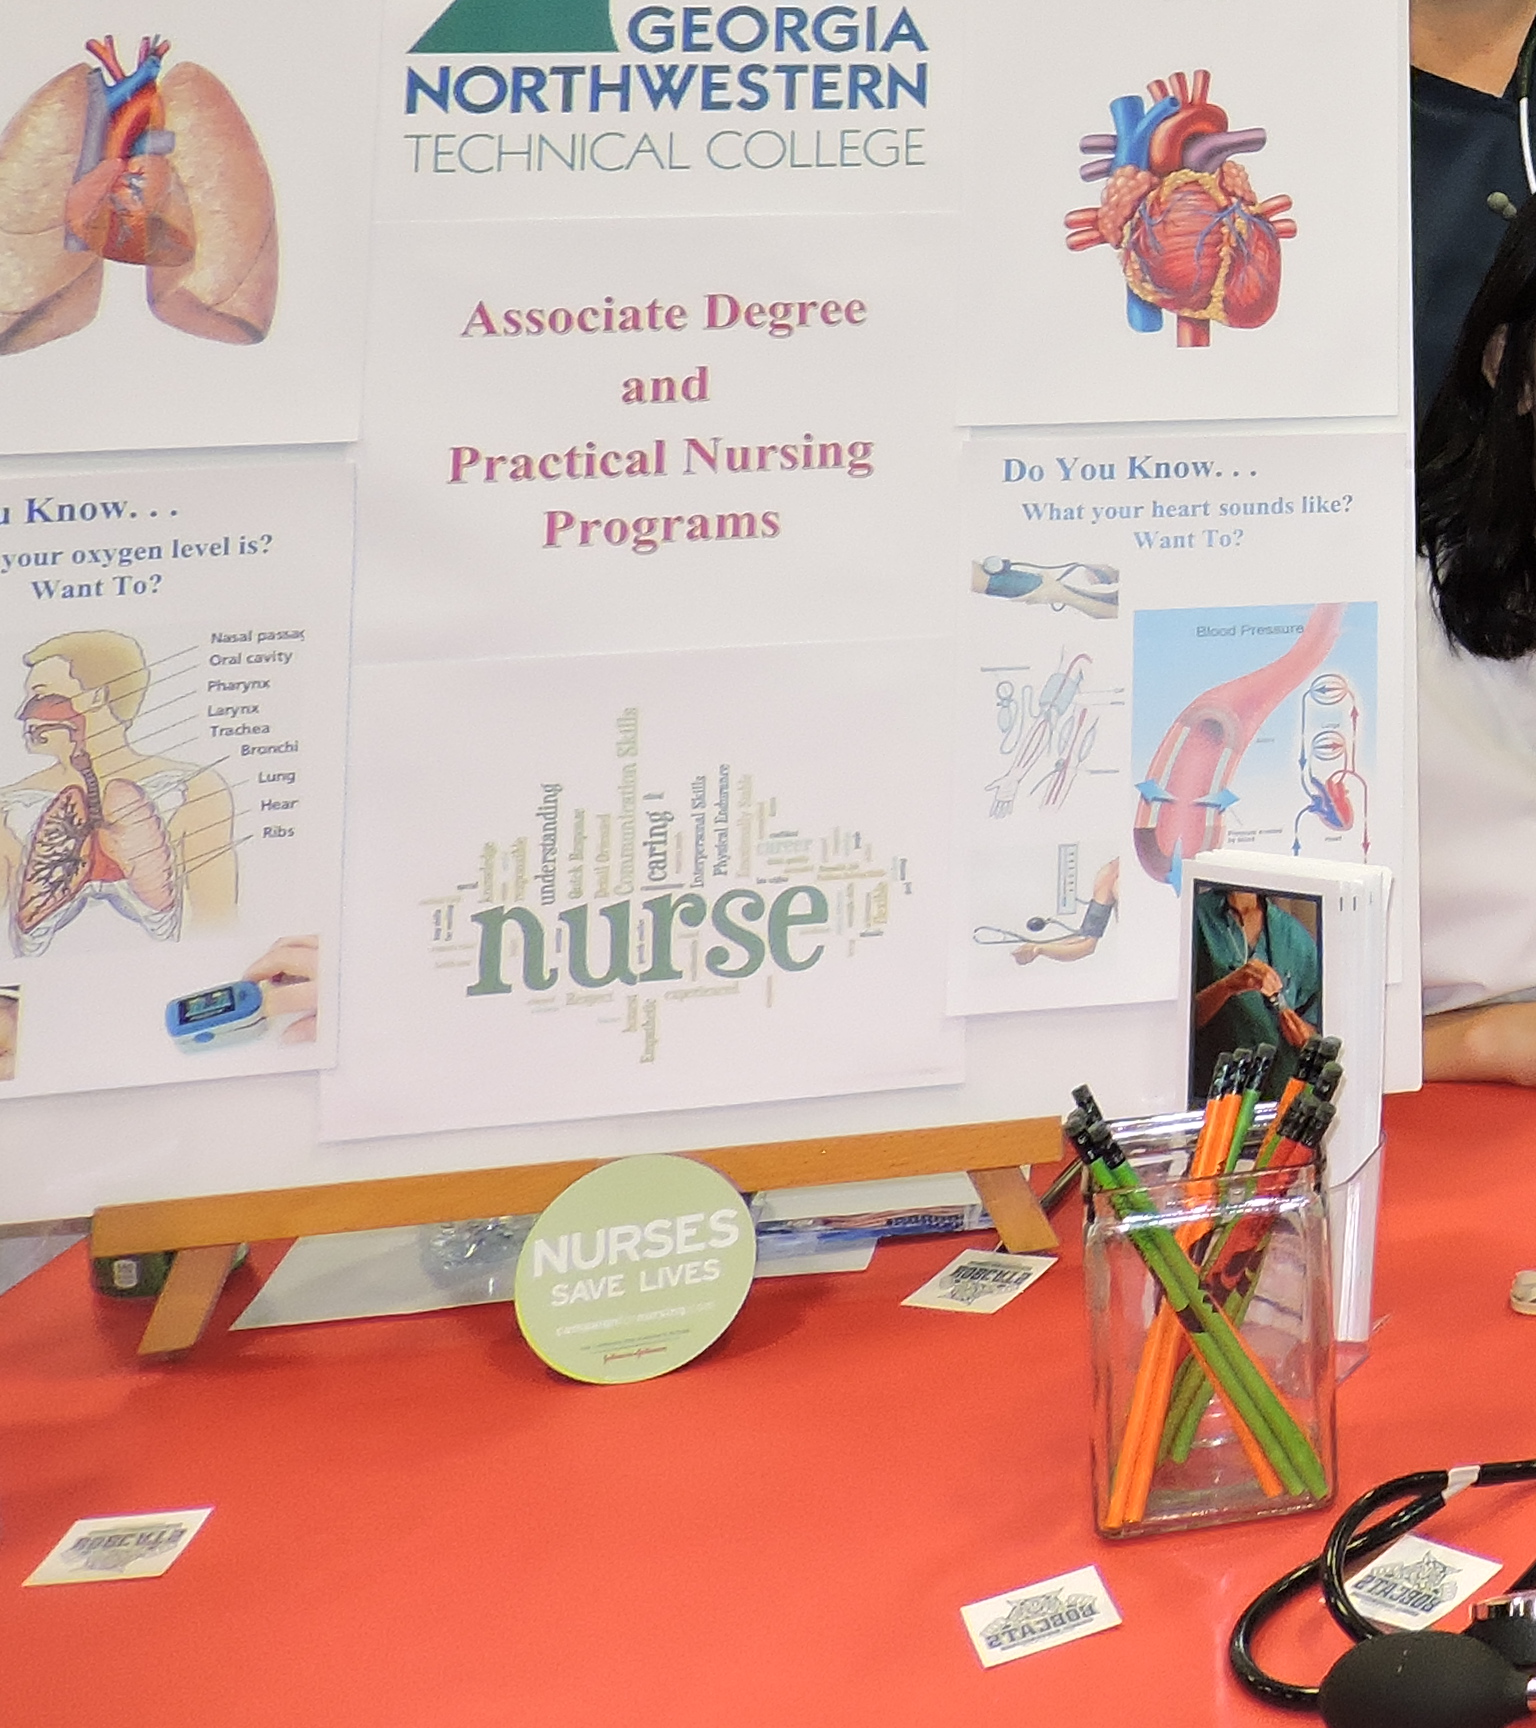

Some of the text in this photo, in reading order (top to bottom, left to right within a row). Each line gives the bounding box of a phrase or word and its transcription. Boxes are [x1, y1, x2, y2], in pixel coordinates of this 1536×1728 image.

[627, 4, 930, 54] GEORGIA
[404, 62, 930, 115] NORTHWESTERN
[404, 127, 926, 173] TECHNICAL COLLEGE
[460, 292, 868, 339] Associate Degree
[621, 365, 711, 405] and
[446, 433, 875, 484] Practical Nursing
[1002, 457, 1115, 482] Do You
[1022, 494, 1353, 524] What your heart sounds like?
[541, 508, 782, 555] Programs
[1134, 529, 1244, 549] Want To?
[0, 533, 273, 572] your oxygen level is?
[32, 574, 163, 601] Want To?
[211, 630, 252, 644] Nasal
[1196, 624, 1304, 638] Blood Pressure
[209, 650, 293, 666] Oral cavity
[207, 679, 271, 693] Pharynx
[207, 705, 259, 718] Larynx
[210, 724, 270, 737] Trachea
[258, 771, 297, 784] Lung
[691, 775, 707, 809] Skills
[613, 707, 640, 898] Communication Skills
[263, 826, 295, 838] Ribs
[535, 782, 563, 907] understanding
[645, 810, 674, 884] caring
[466, 884, 830, 997] nurse
[533, 1209, 739, 1278] NURSES
[551, 1259, 720, 1306] SAVE LIVES
